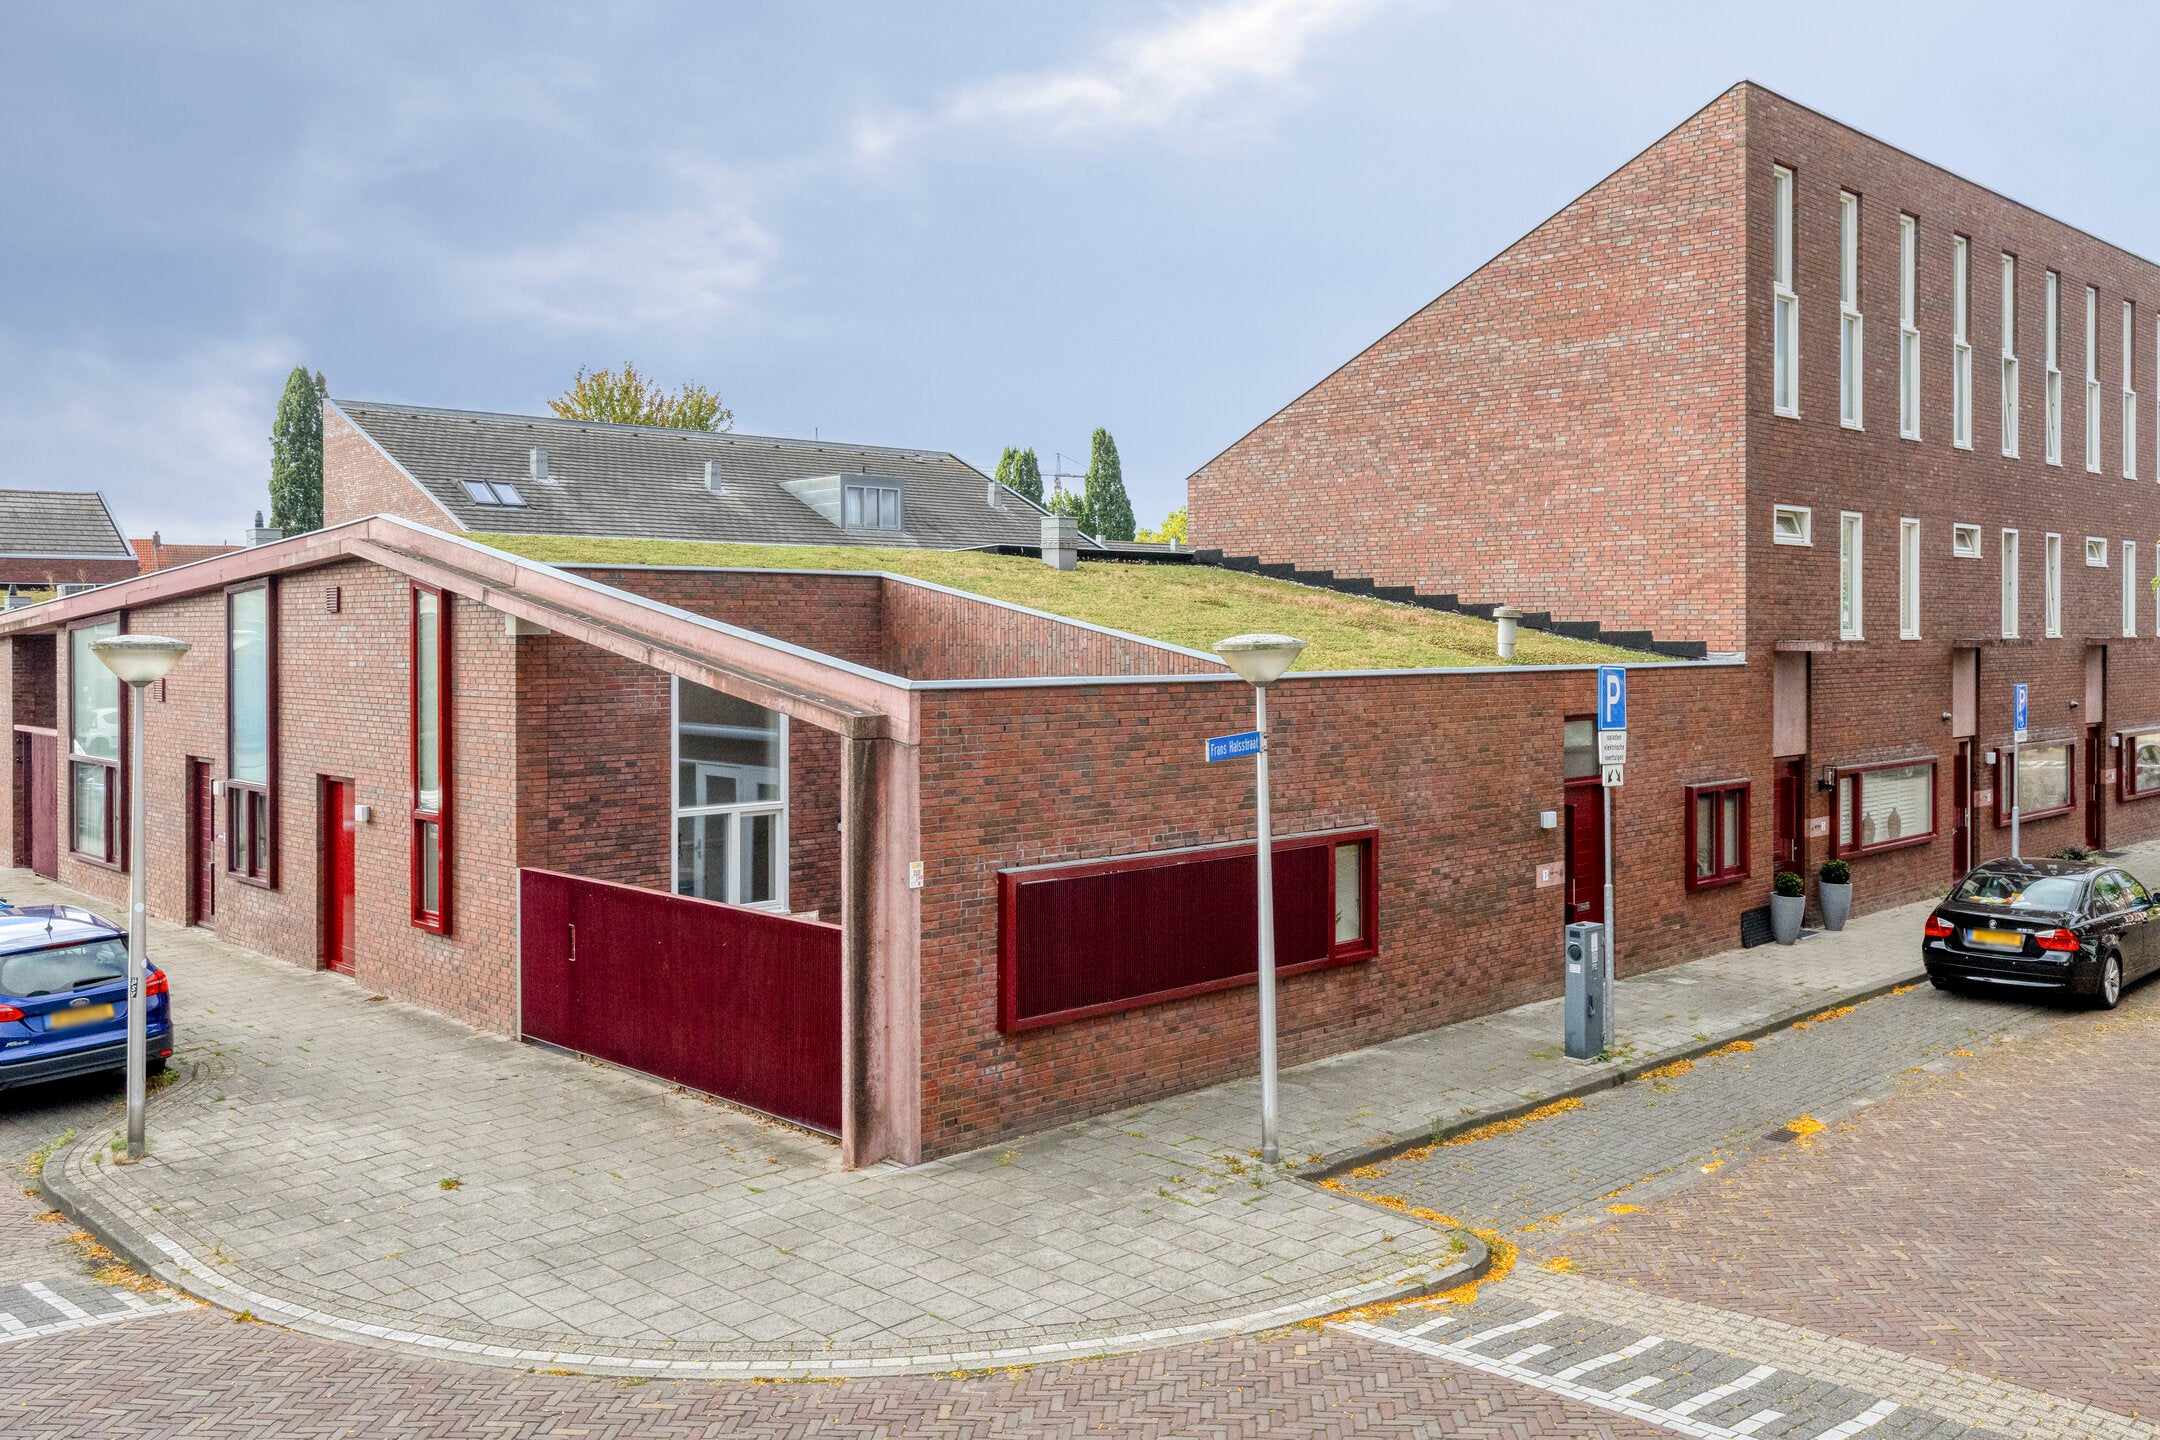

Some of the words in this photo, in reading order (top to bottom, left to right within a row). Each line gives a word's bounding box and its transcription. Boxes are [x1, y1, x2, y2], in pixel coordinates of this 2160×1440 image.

[1607, 675, 1621, 722] P
[2019, 689, 2025, 711] P
[1210, 743, 1227, 756] Frans
[1229, 736, 1259, 753] Halsstraat
